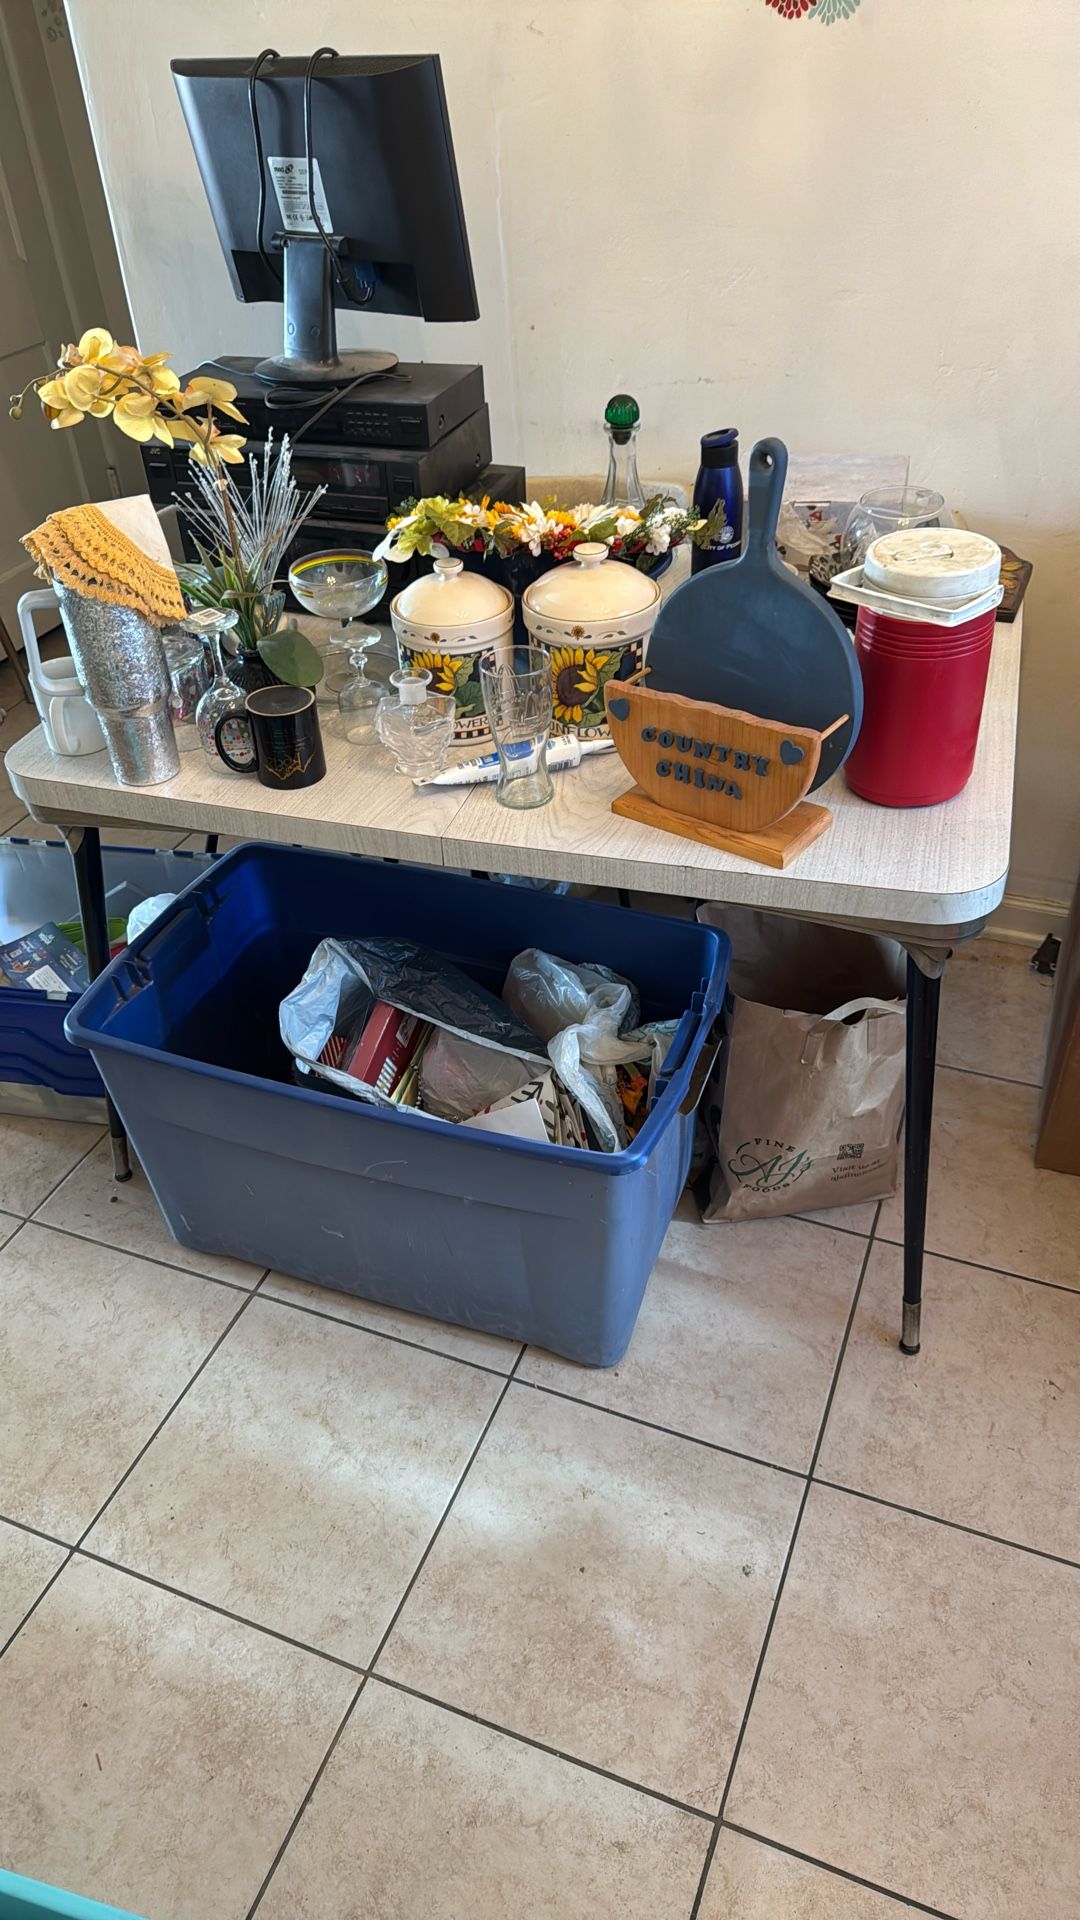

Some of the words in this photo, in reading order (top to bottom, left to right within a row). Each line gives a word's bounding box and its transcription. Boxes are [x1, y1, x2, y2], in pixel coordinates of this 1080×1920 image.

[550, 721, 611, 738] UNFLOW
[641, 726, 771, 777] COUNTRY
[656, 759, 743, 800] CHINA
[754, 1138, 796, 1152] FINE
[743, 1181, 791, 1193] FOODS
